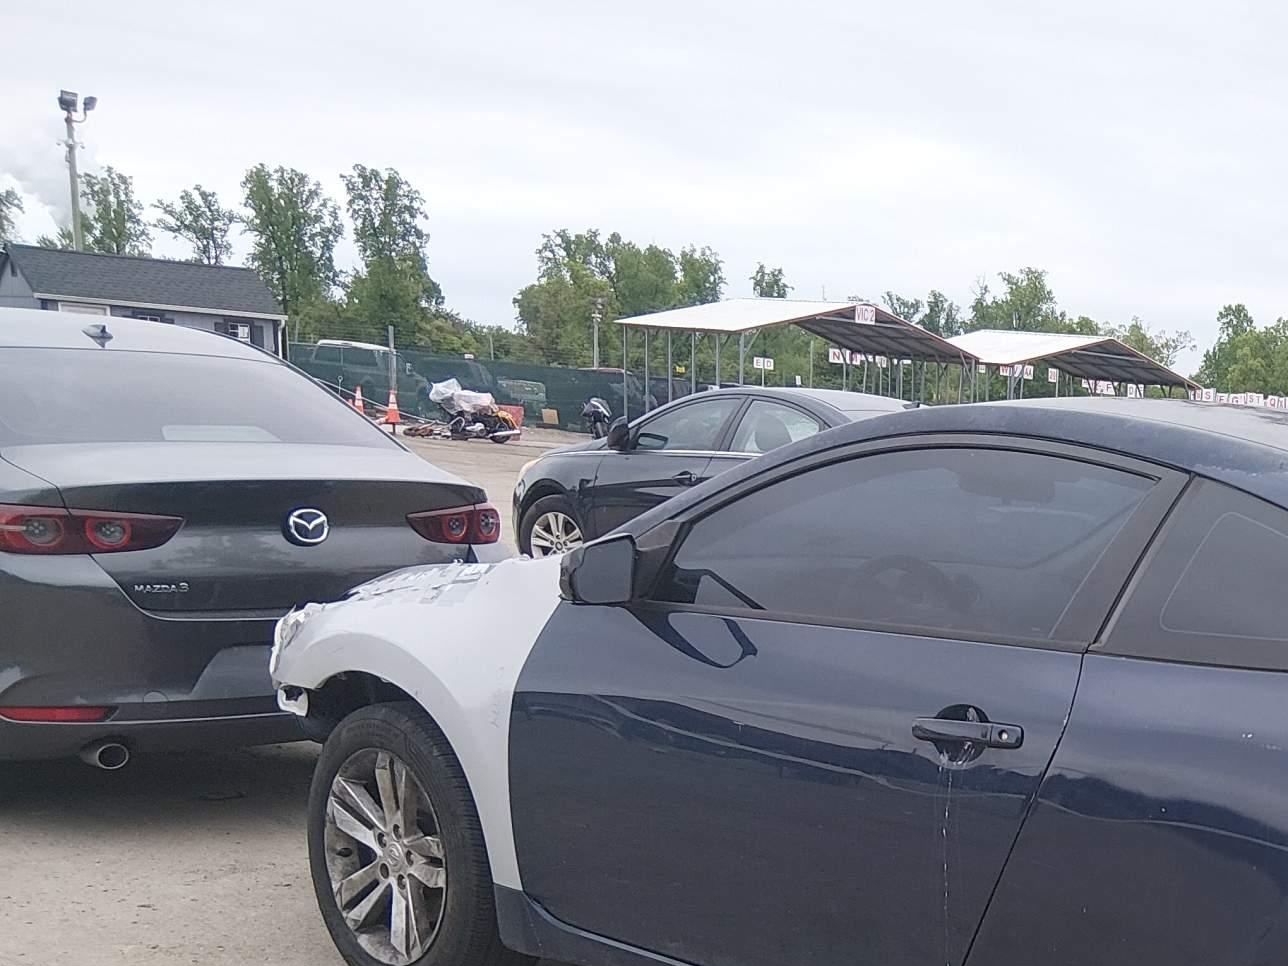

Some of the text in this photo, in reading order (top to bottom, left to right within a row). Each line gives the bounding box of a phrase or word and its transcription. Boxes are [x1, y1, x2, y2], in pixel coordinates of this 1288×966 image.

[856, 307, 875, 322] VIC 2
[832, 351, 840, 361] N
[755, 359, 761, 367] E
[766, 360, 772, 368] D
[1204, 391, 1211, 400] S
